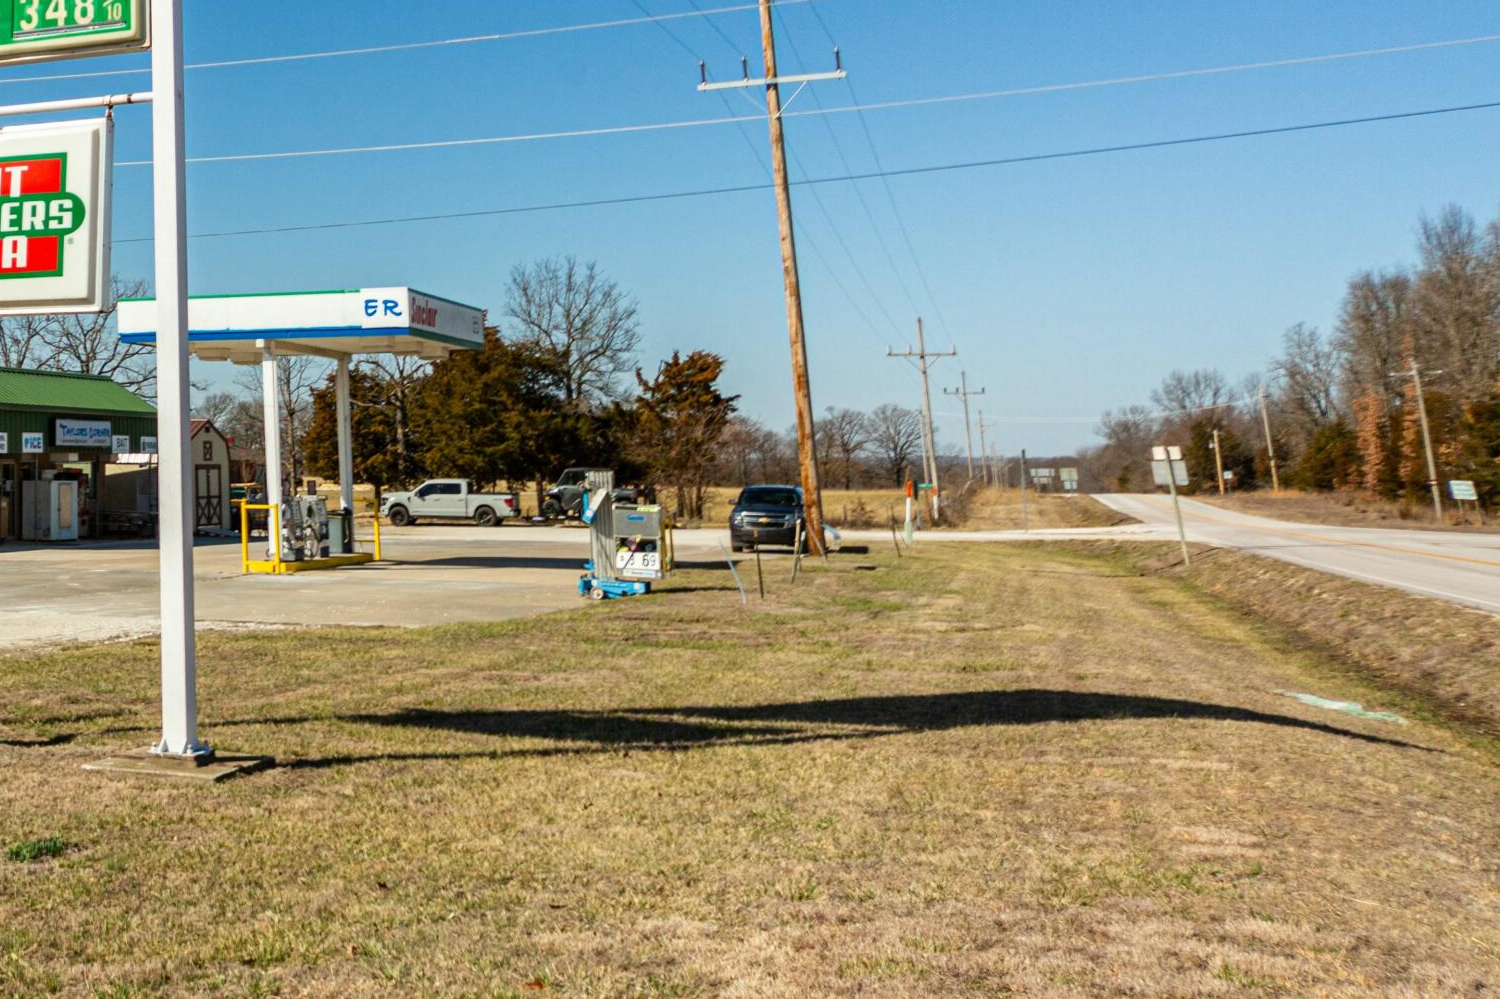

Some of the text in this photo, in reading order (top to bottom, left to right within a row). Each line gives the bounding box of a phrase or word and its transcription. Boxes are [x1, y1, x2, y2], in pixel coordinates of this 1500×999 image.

[411, 296, 437, 328] Sinclair
[29, 436, 42, 449] ICE
[116, 437, 128, 448] BAIT
